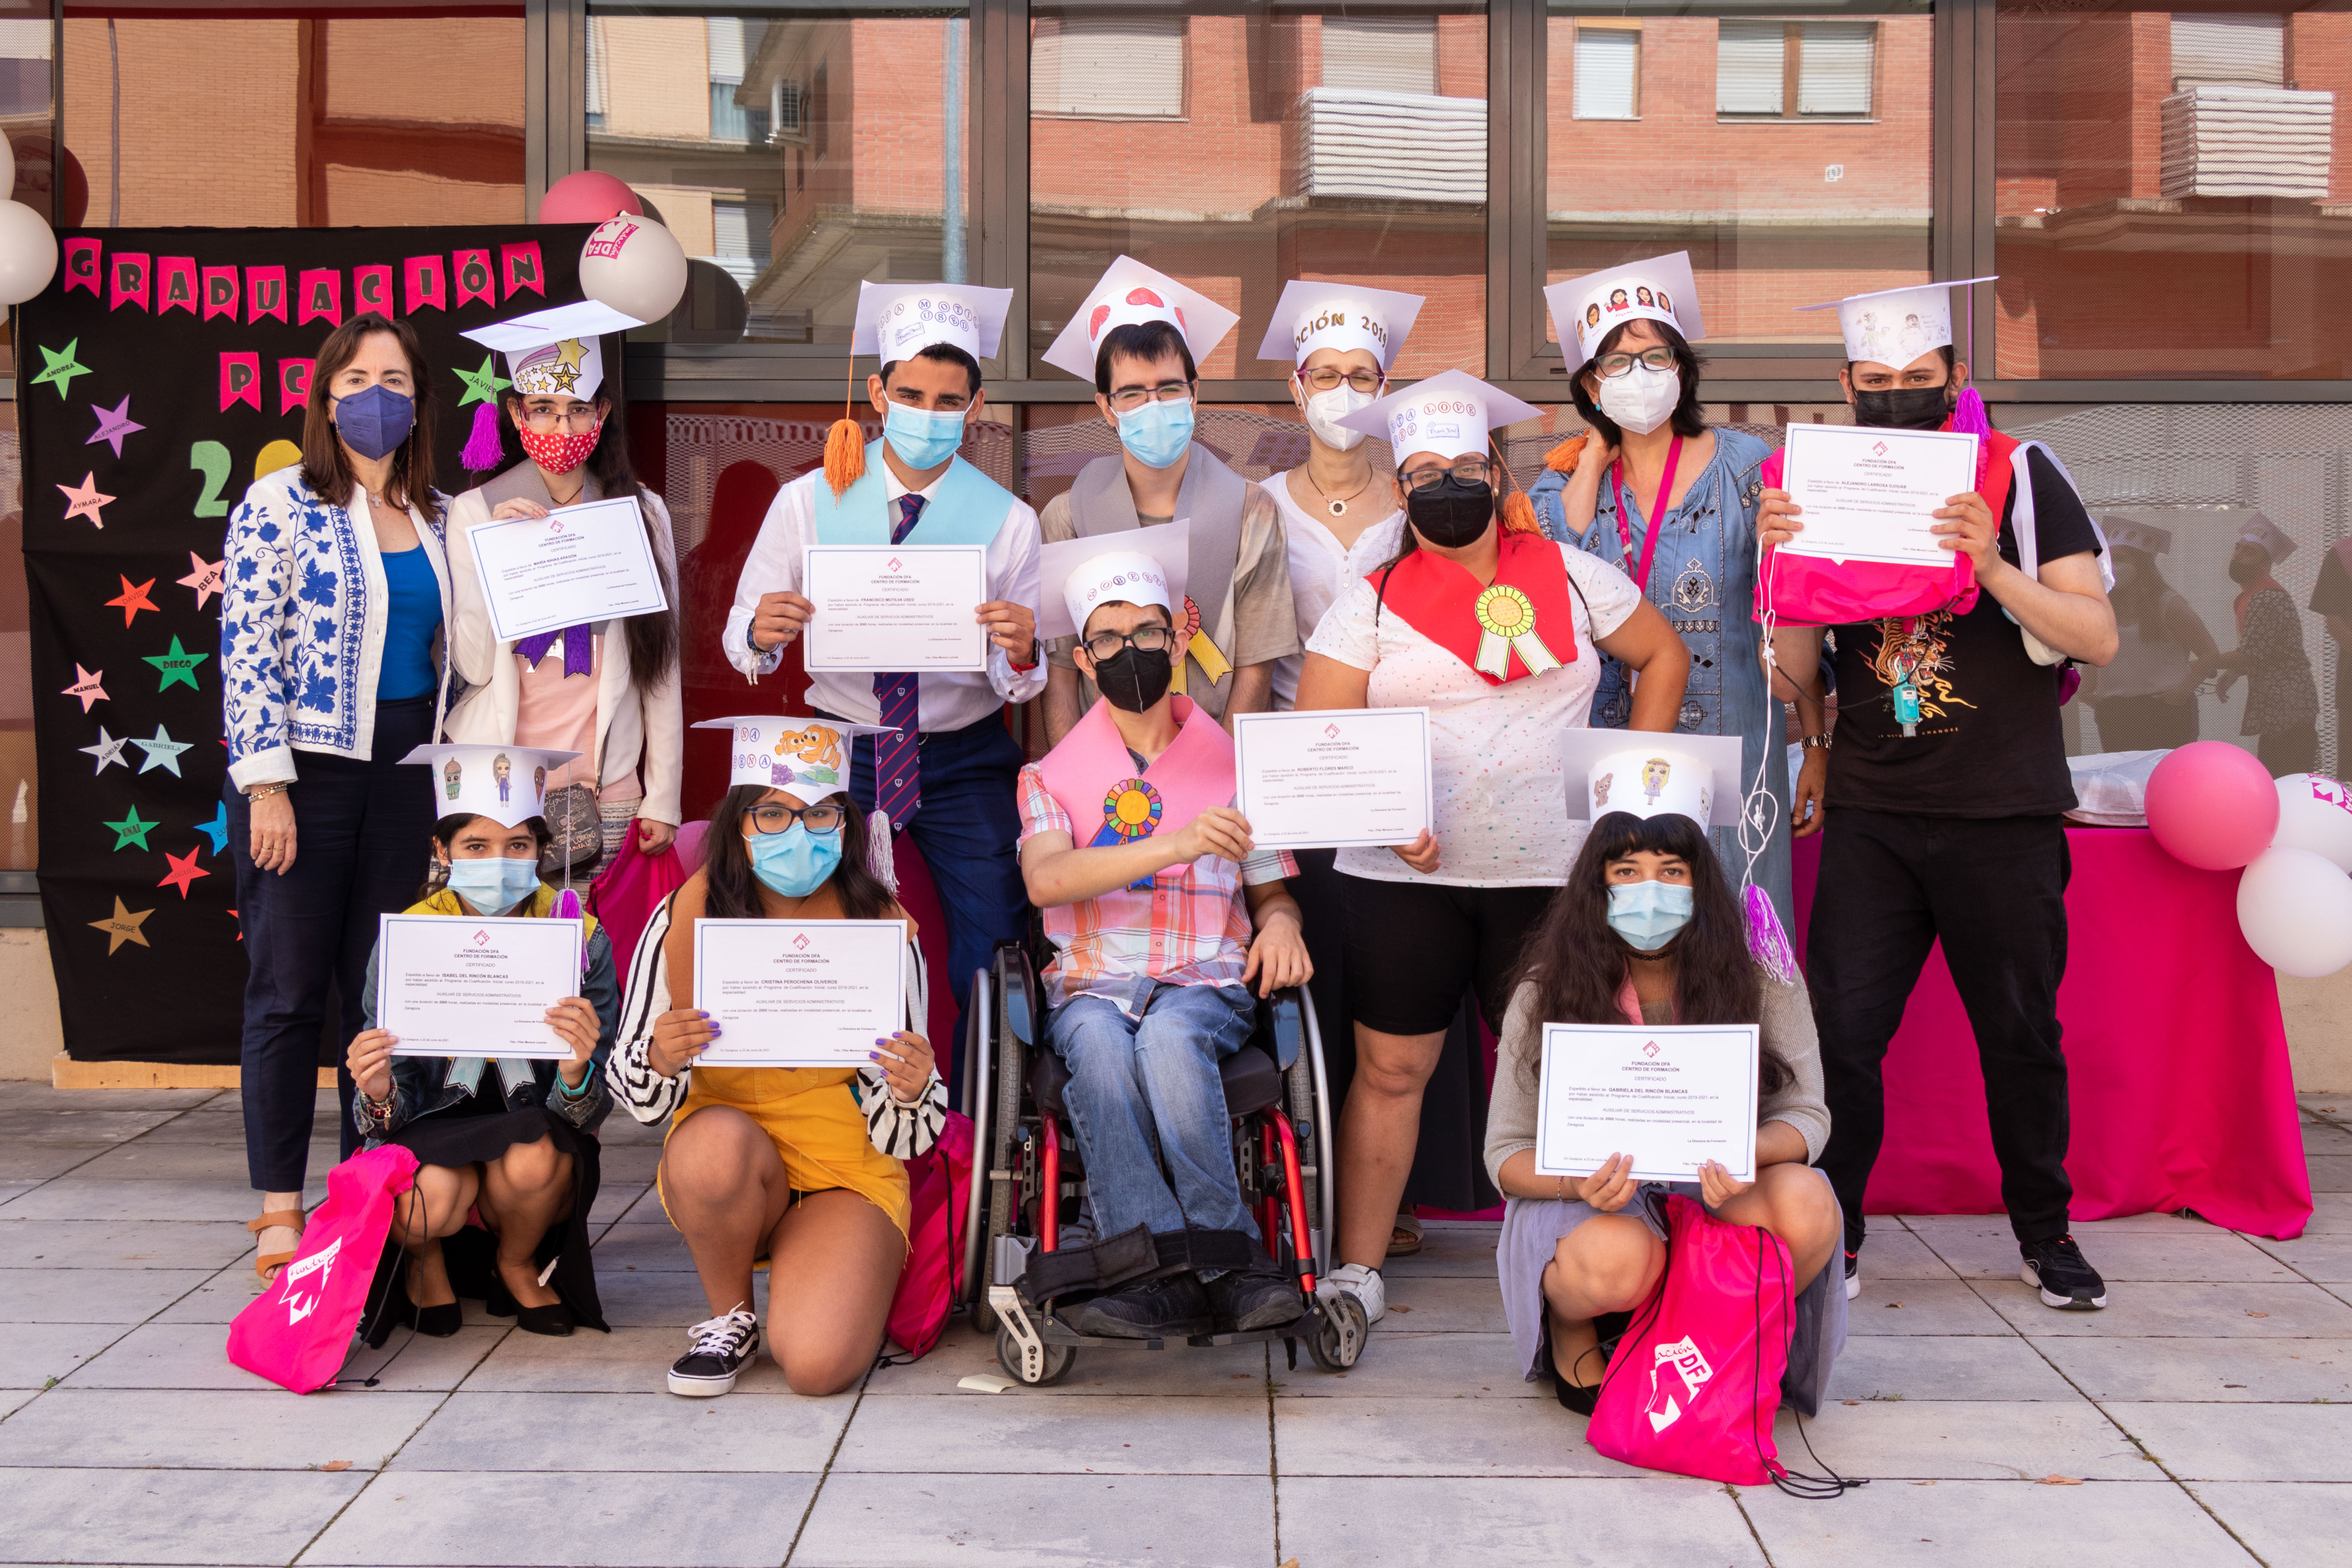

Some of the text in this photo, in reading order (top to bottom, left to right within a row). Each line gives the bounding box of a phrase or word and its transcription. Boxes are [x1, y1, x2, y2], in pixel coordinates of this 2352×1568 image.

[588, 243, 613, 255] DFA
[46, 363, 75, 379] ANDREA
[469, 375, 497, 395] JAVIER
[1424, 401, 1476, 417] LOVE
[94, 420, 131, 441] ALEJANDRO
[73, 497, 103, 510] AYMARA
[198, 570, 219, 592] BEA
[122, 590, 144, 605] DAVID
[162, 659, 192, 669] DIEGO
[73, 683, 100, 693] MANUEL
[1922, 727, 1959, 736] CHANGES
[101, 742, 121, 762] ADRIÁN
[141, 741, 181, 752] GABRIELA
[122, 824, 141, 837] UNAI
[171, 868, 197, 880] MIGUEL
[110, 922, 136, 933] JORGE
